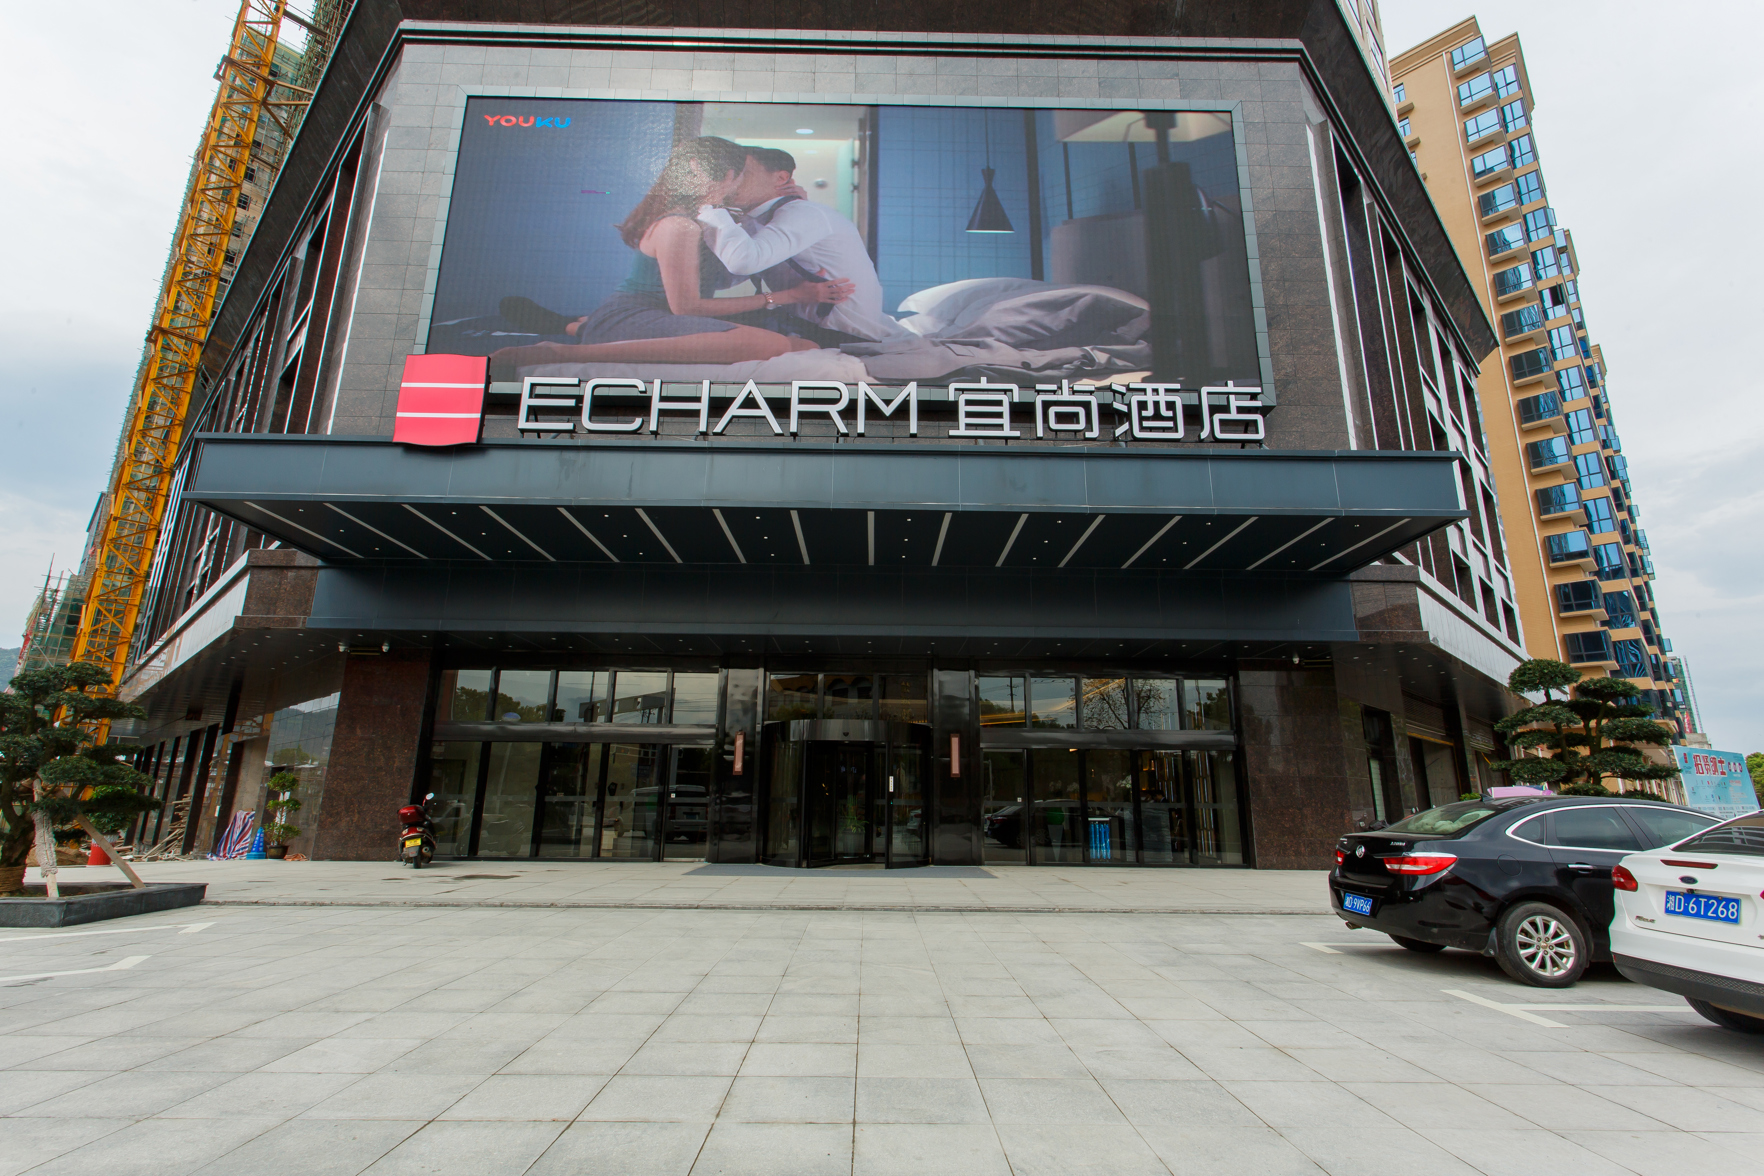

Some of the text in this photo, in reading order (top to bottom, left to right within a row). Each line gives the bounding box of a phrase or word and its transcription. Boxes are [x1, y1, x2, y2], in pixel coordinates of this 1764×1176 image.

[484, 115, 571, 128] YOUKU
[518, 376, 1266, 441] ECHARM 宜尚酒店
